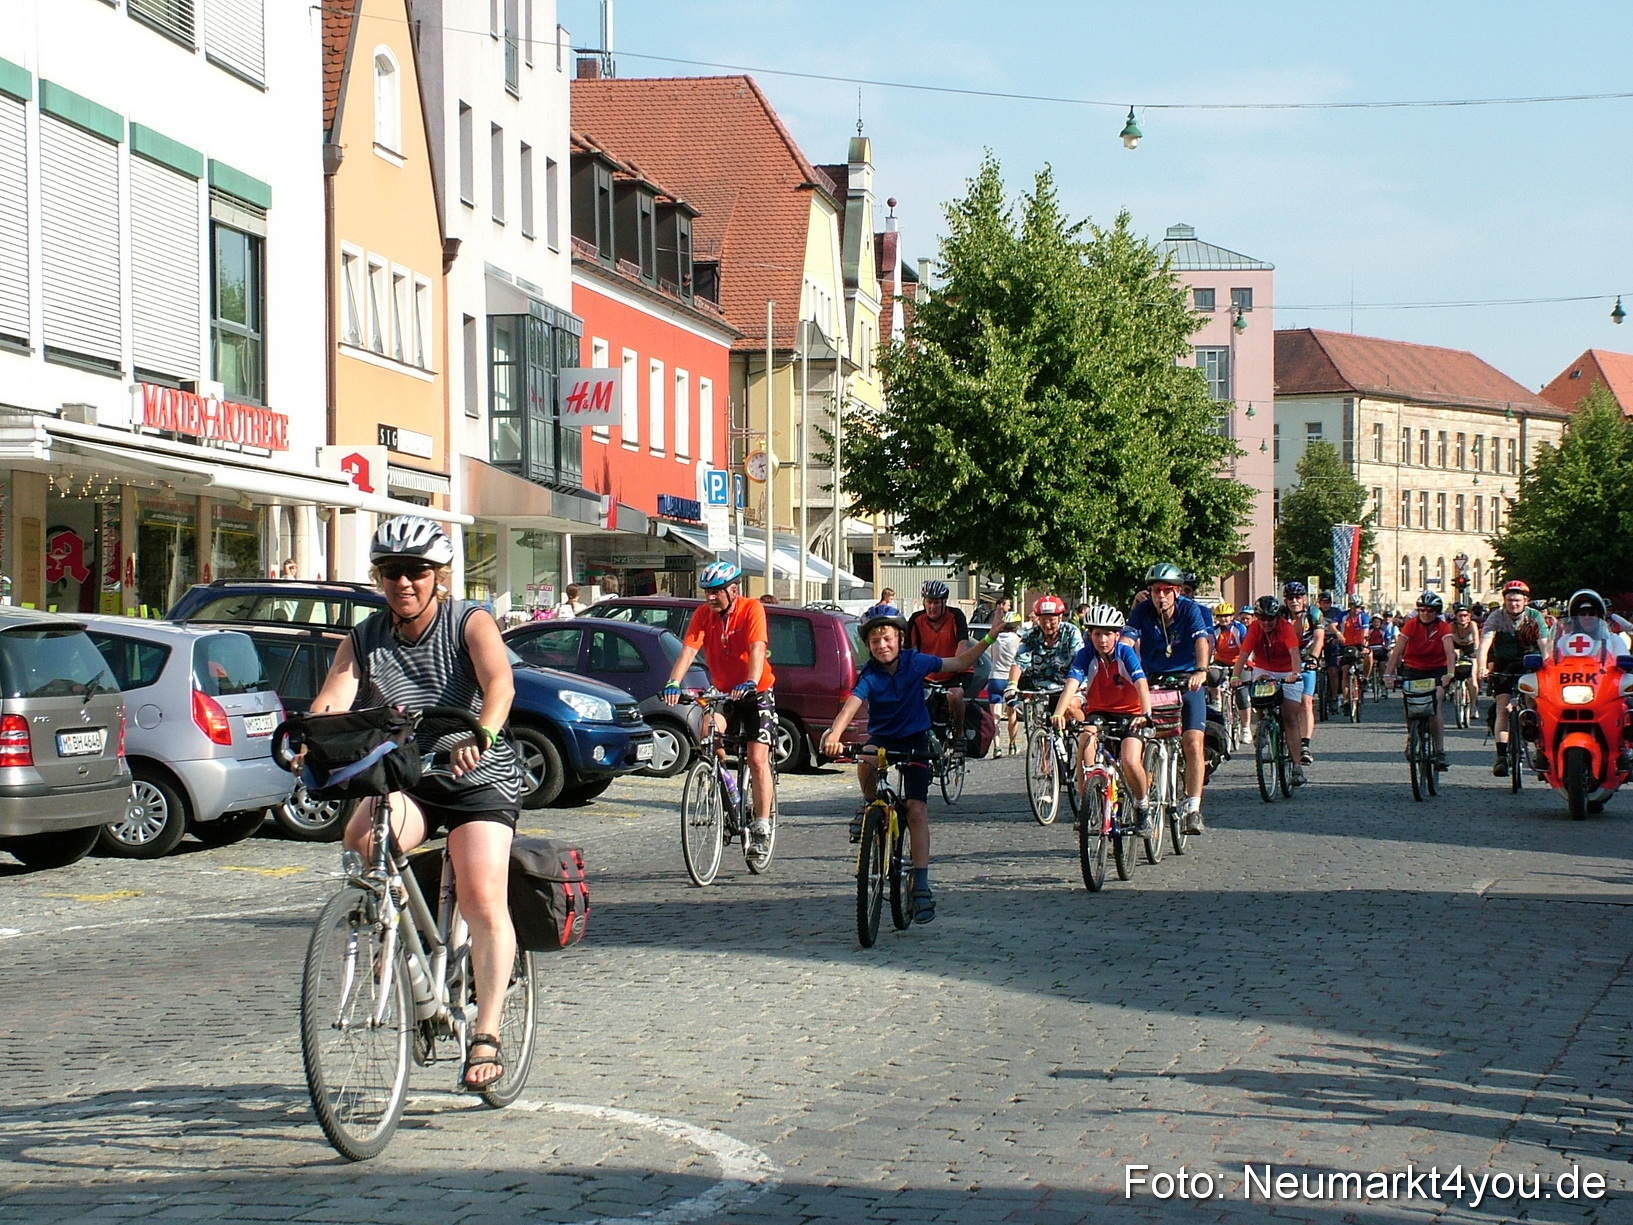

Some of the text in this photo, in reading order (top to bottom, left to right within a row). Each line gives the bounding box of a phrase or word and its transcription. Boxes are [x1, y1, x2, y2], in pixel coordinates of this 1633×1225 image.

[566, 381, 614, 414] H&M
[142, 383, 289, 451] MARIEN-APOTHEKE
[711, 474, 724, 501] P
[1559, 672, 1599, 685] BRK
